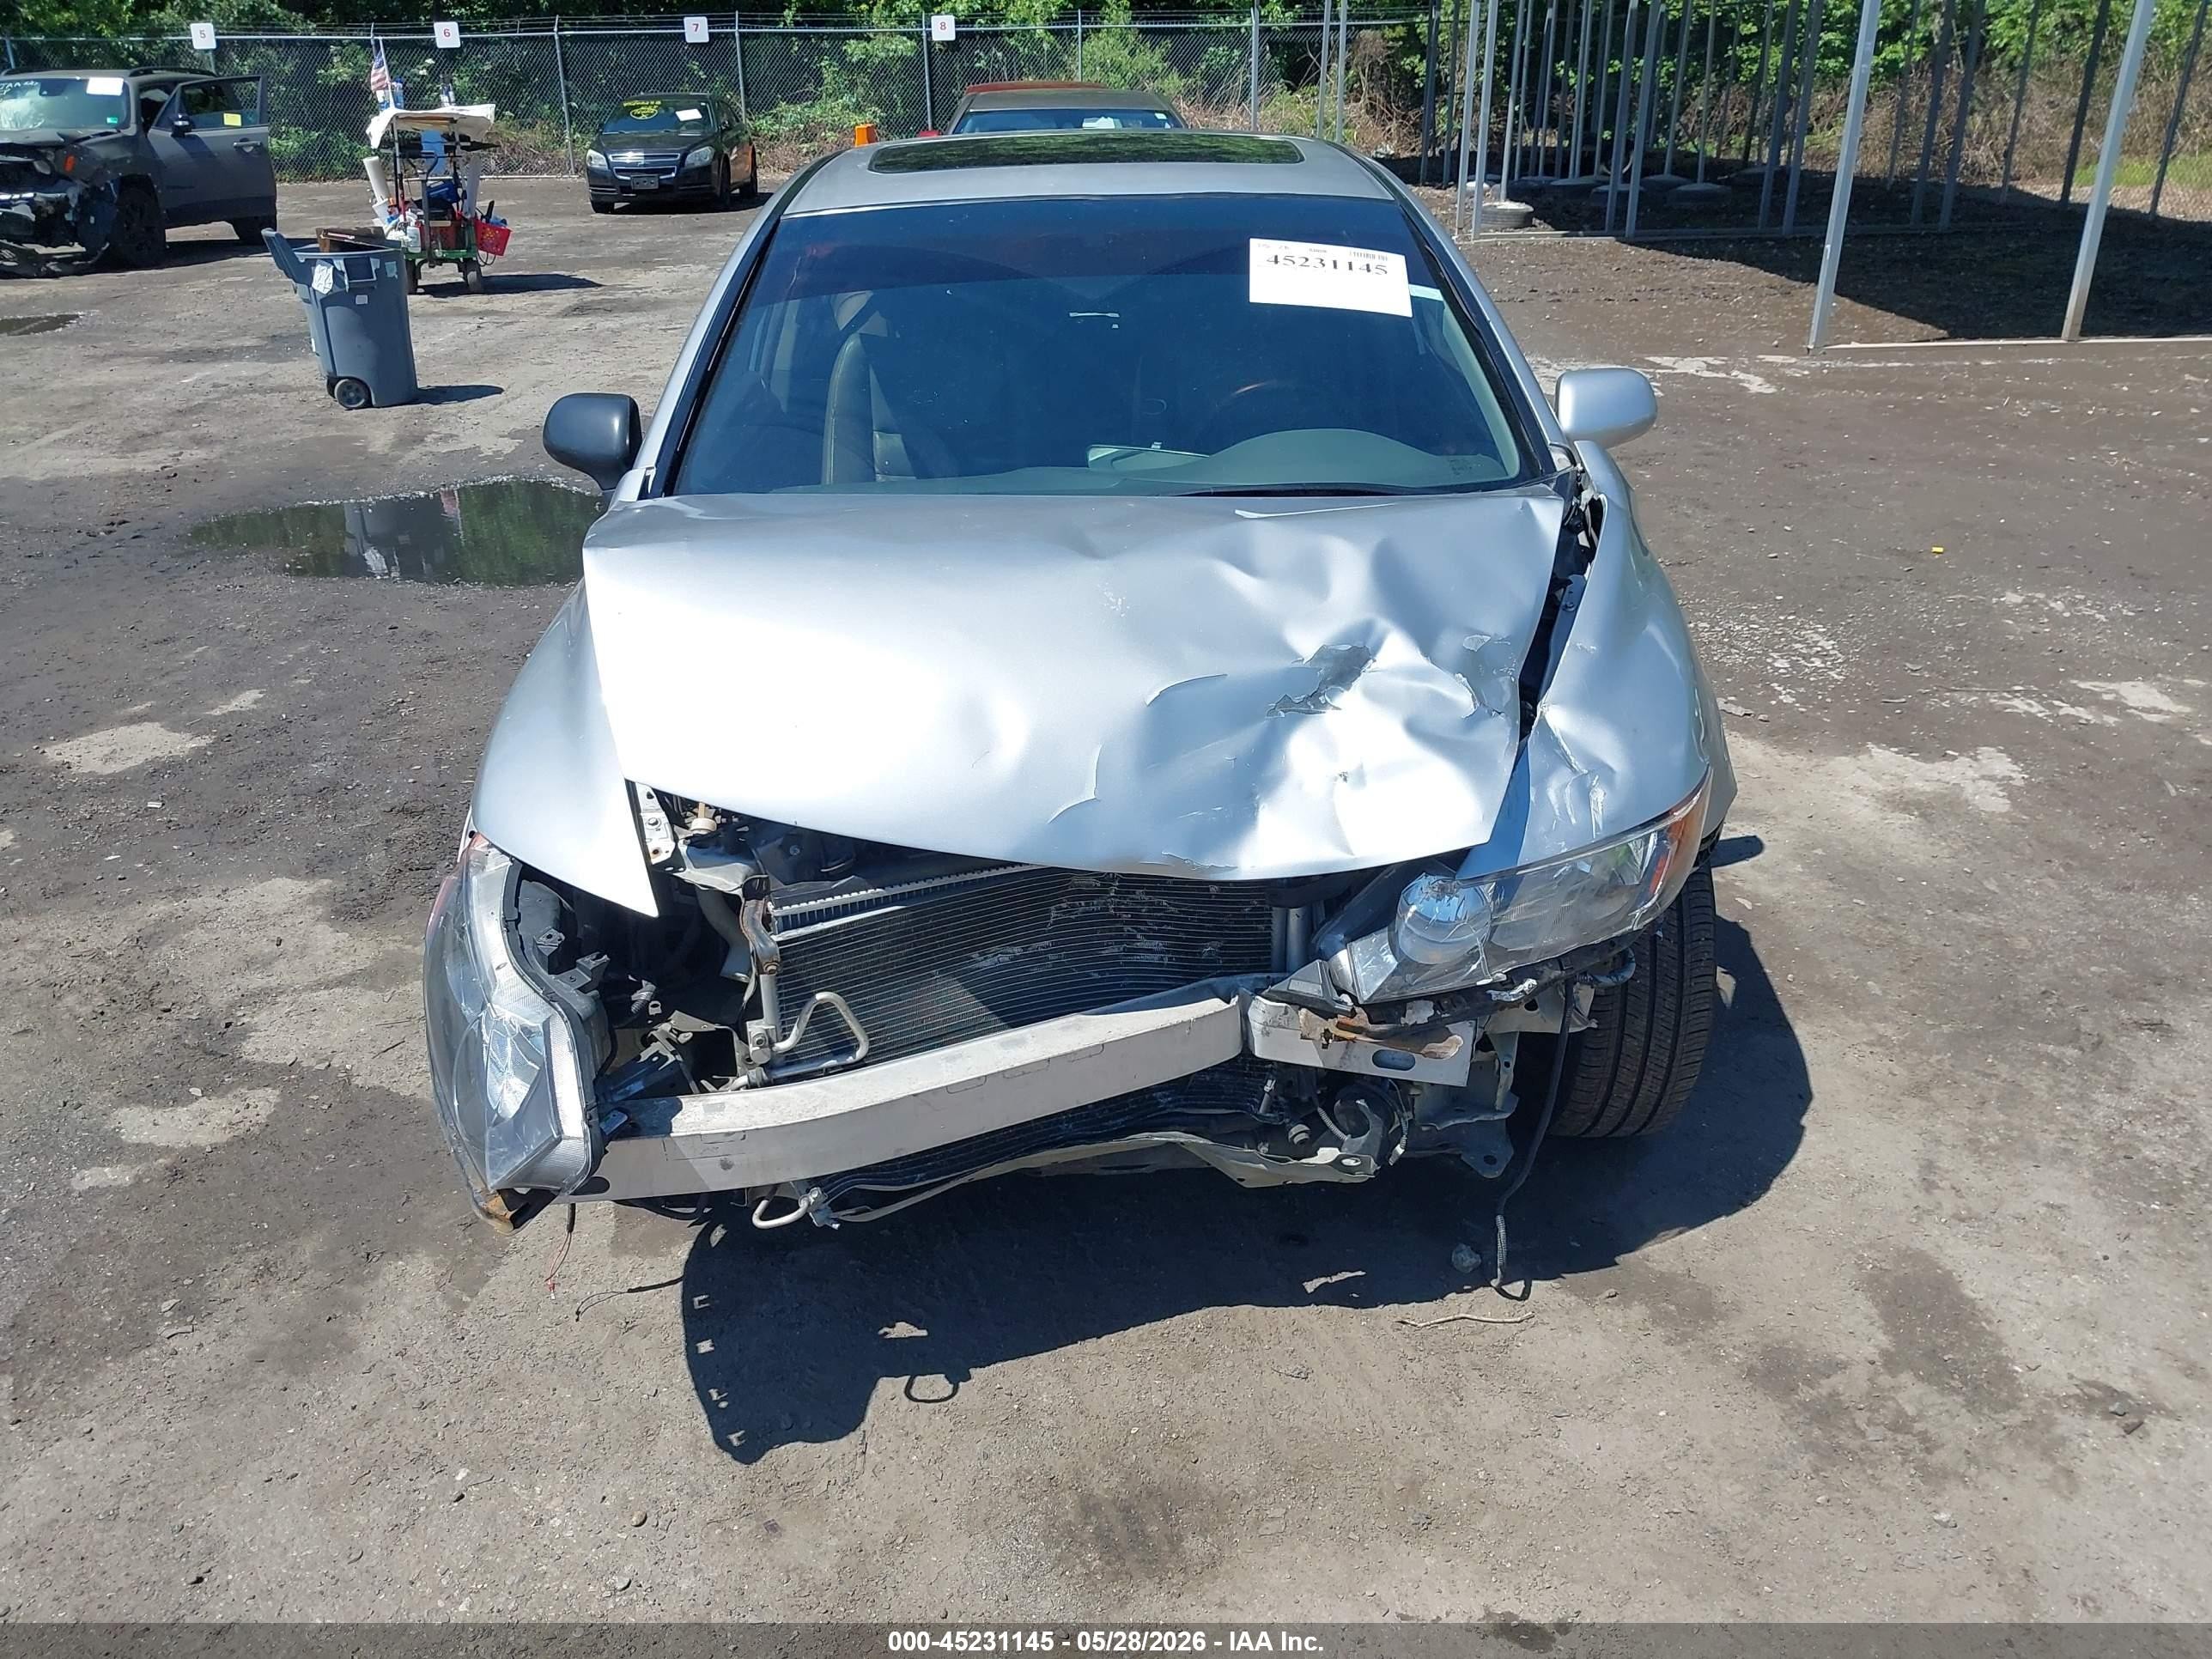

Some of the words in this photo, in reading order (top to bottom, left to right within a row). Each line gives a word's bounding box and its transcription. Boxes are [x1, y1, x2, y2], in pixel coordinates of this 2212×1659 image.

[692, 23, 700, 33] 7
[939, 21, 948, 31] 8
[198, 29, 206, 40] 5
[443, 29, 451, 39] 6
[1267, 254, 1388, 276] 45231145
